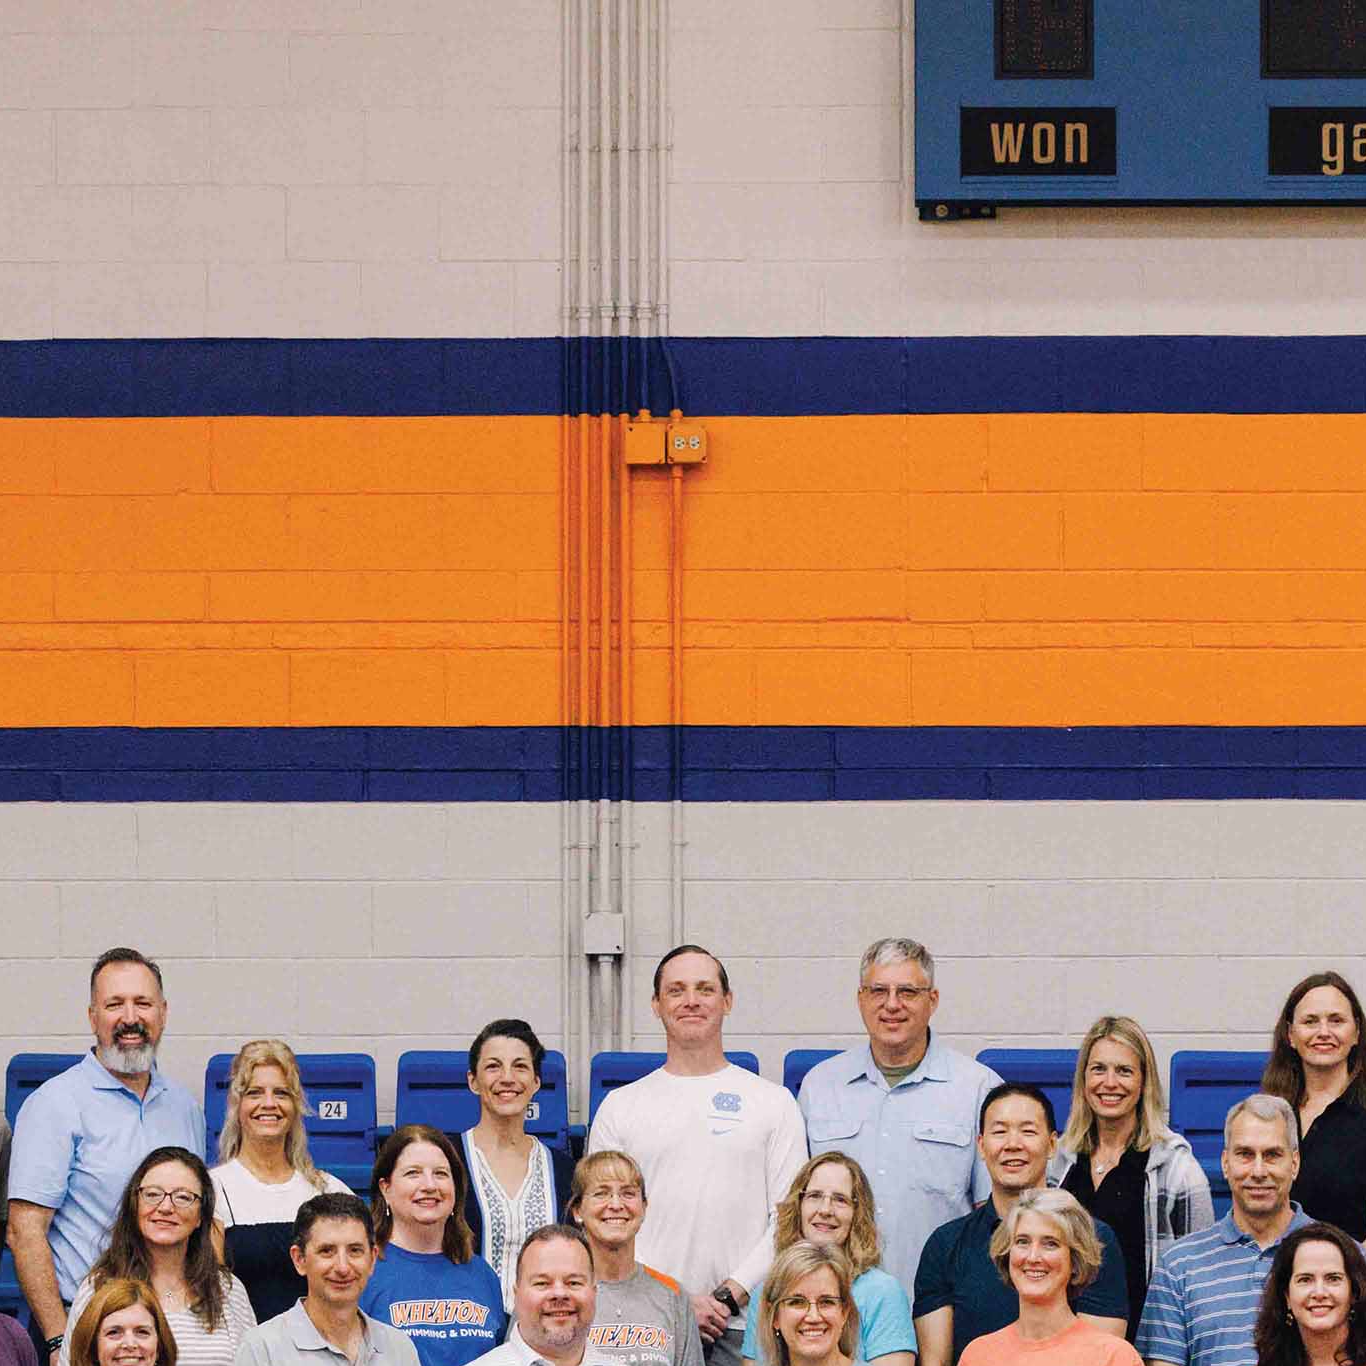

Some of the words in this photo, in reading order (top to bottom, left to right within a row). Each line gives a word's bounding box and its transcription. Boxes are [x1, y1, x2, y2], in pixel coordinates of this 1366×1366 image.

[990, 120, 1090, 165] won
[324, 1102, 343, 1119] 24
[390, 1300, 490, 1327] WHEATON
[402, 1328, 447, 1339] WIMMING
[450, 1329, 457, 1338] &
[460, 1328, 495, 1339] DIVING
[588, 1324, 669, 1352] HEATON
